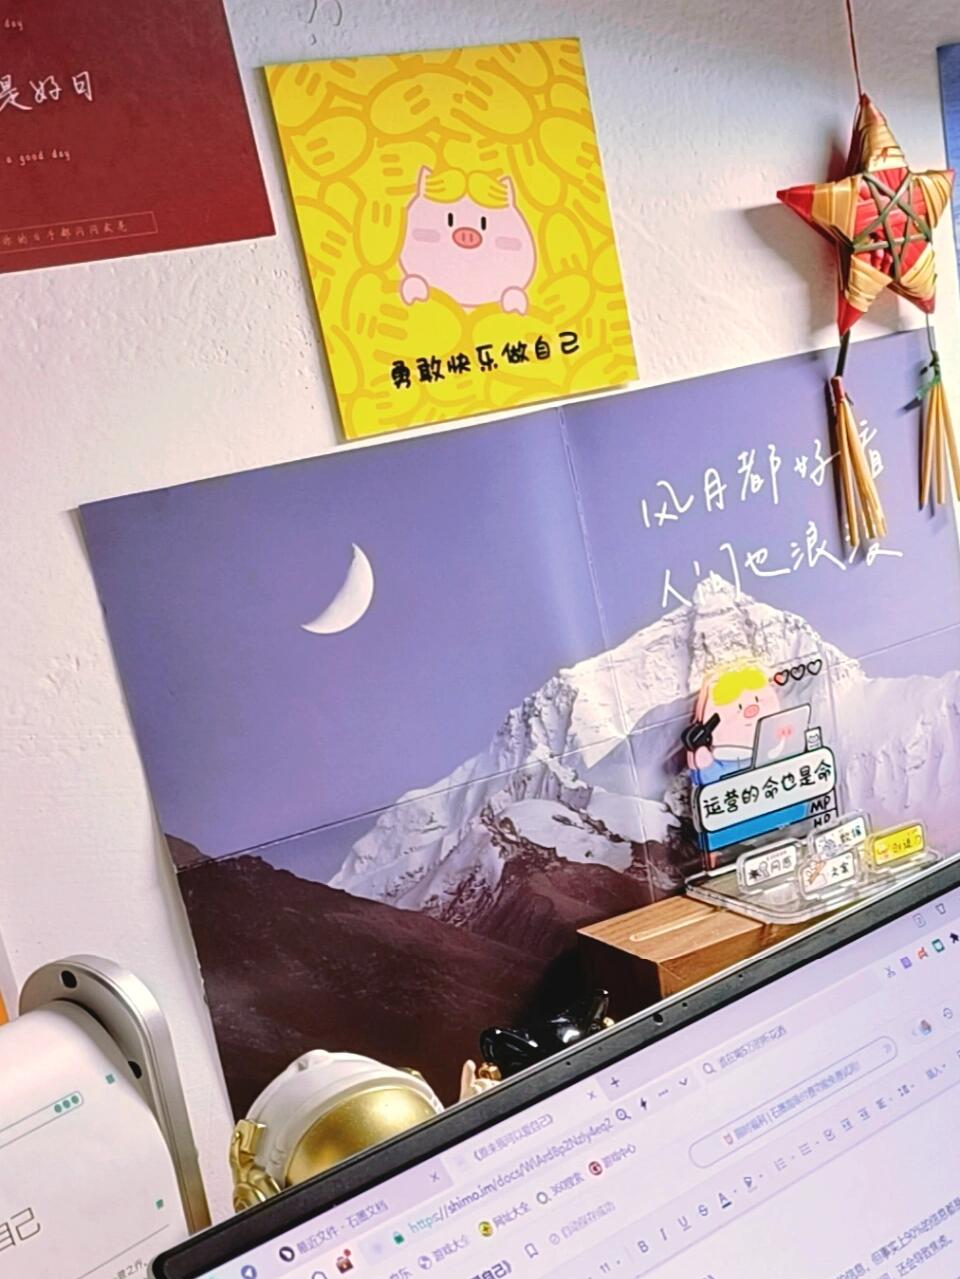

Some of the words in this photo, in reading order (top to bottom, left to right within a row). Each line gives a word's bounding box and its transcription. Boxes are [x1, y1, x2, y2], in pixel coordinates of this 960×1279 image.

[20, 151, 45, 166] good
[52, 148, 71, 161] day
[391, 330, 580, 391] 勇敢快乐做自己
[702, 758, 833, 819] 运营的命也是命
